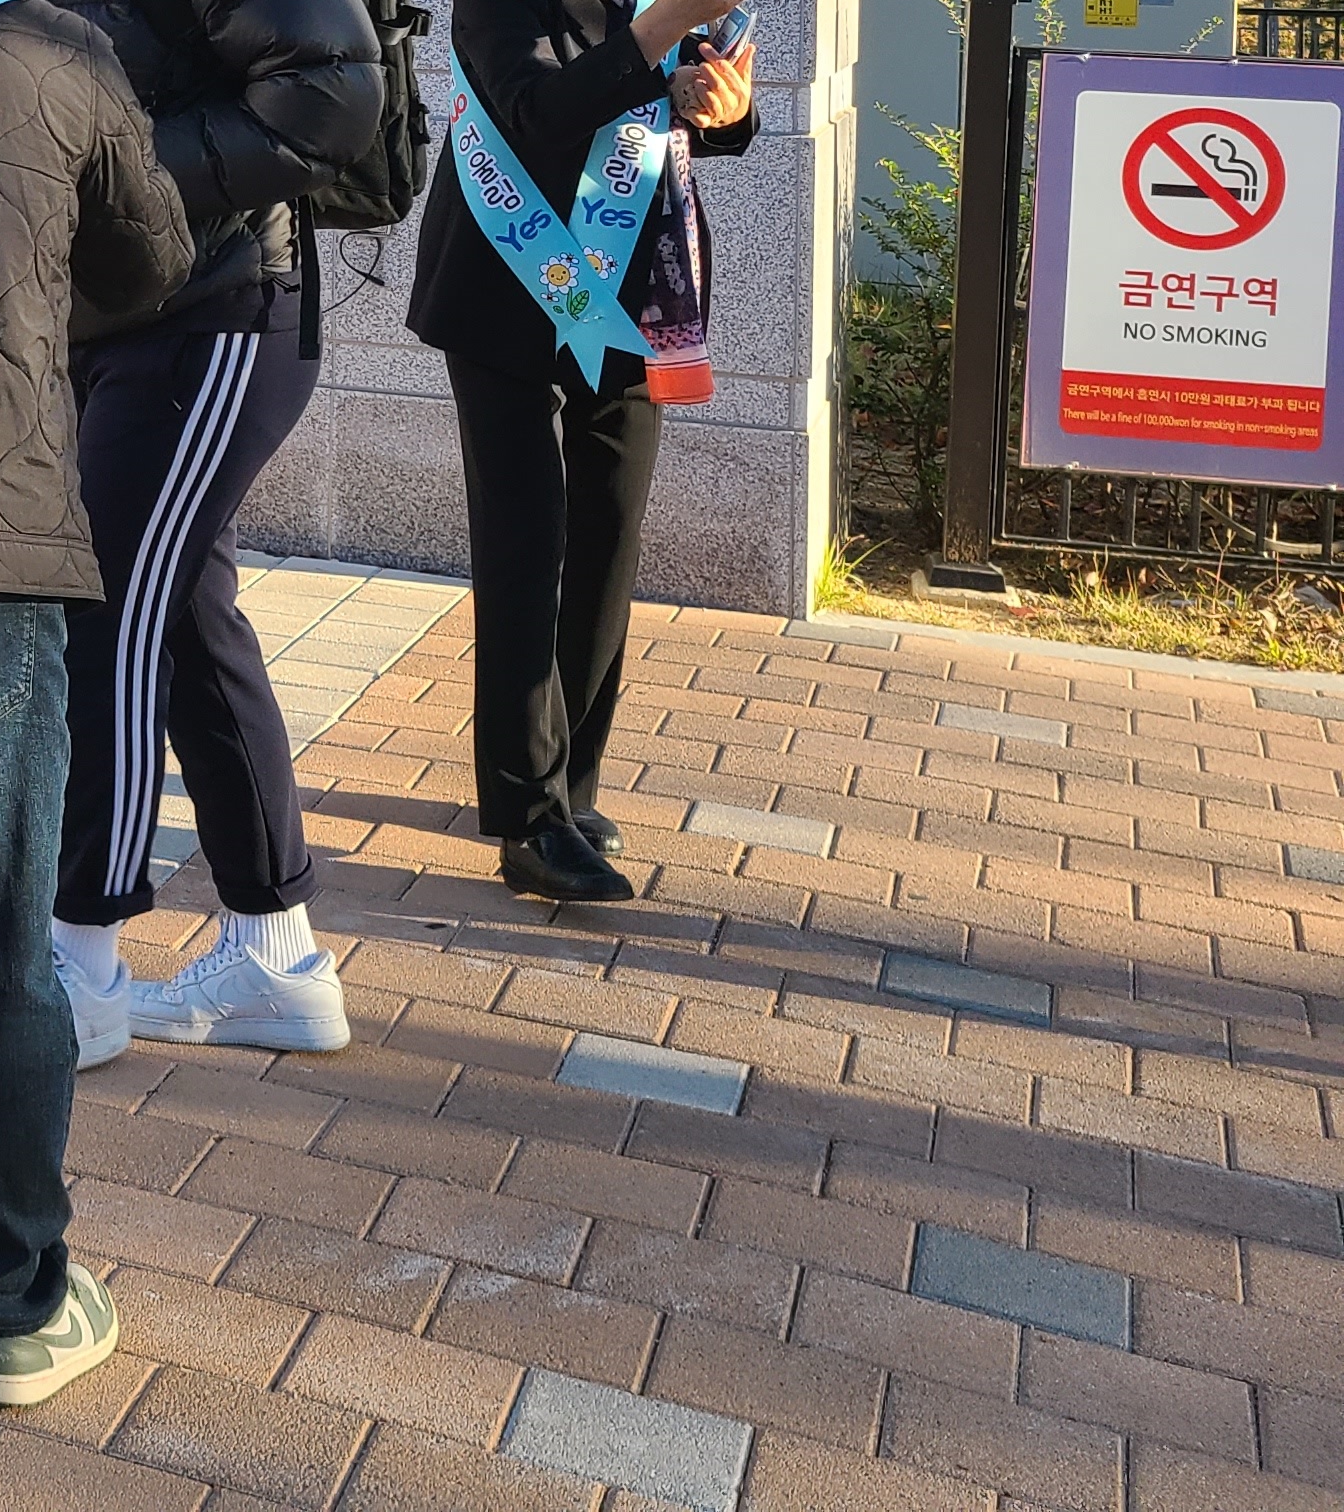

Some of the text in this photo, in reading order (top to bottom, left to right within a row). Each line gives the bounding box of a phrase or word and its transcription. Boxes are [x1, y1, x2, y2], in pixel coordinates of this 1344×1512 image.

[457, 121, 524, 212] 어울림
[495, 208, 553, 254] Yes
[580, 195, 638, 230] Yes
[1117, 268, 1280, 317] 금연구역
[1123, 321, 1269, 350] NO SMOKING
[1066, 382, 1135, 400] 금연구역에서
[1174, 390, 1211, 405] 10만원
[1212, 394, 1258, 411] 과태료가
[1259, 397, 1284, 412] 부과
[1286, 399, 1321, 414] 됩니다
[1063, 407, 1085, 421] There
[1086, 408, 1099, 422] will
[1100, 410, 1110, 422] be
[1118, 411, 1133, 424] fine
[1133, 413, 1142, 424] of
[1191, 417, 1203, 430] for
[1203, 419, 1236, 434] smoking
[1236, 422, 1244, 432] in
[1297, 426, 1319, 438] areas
